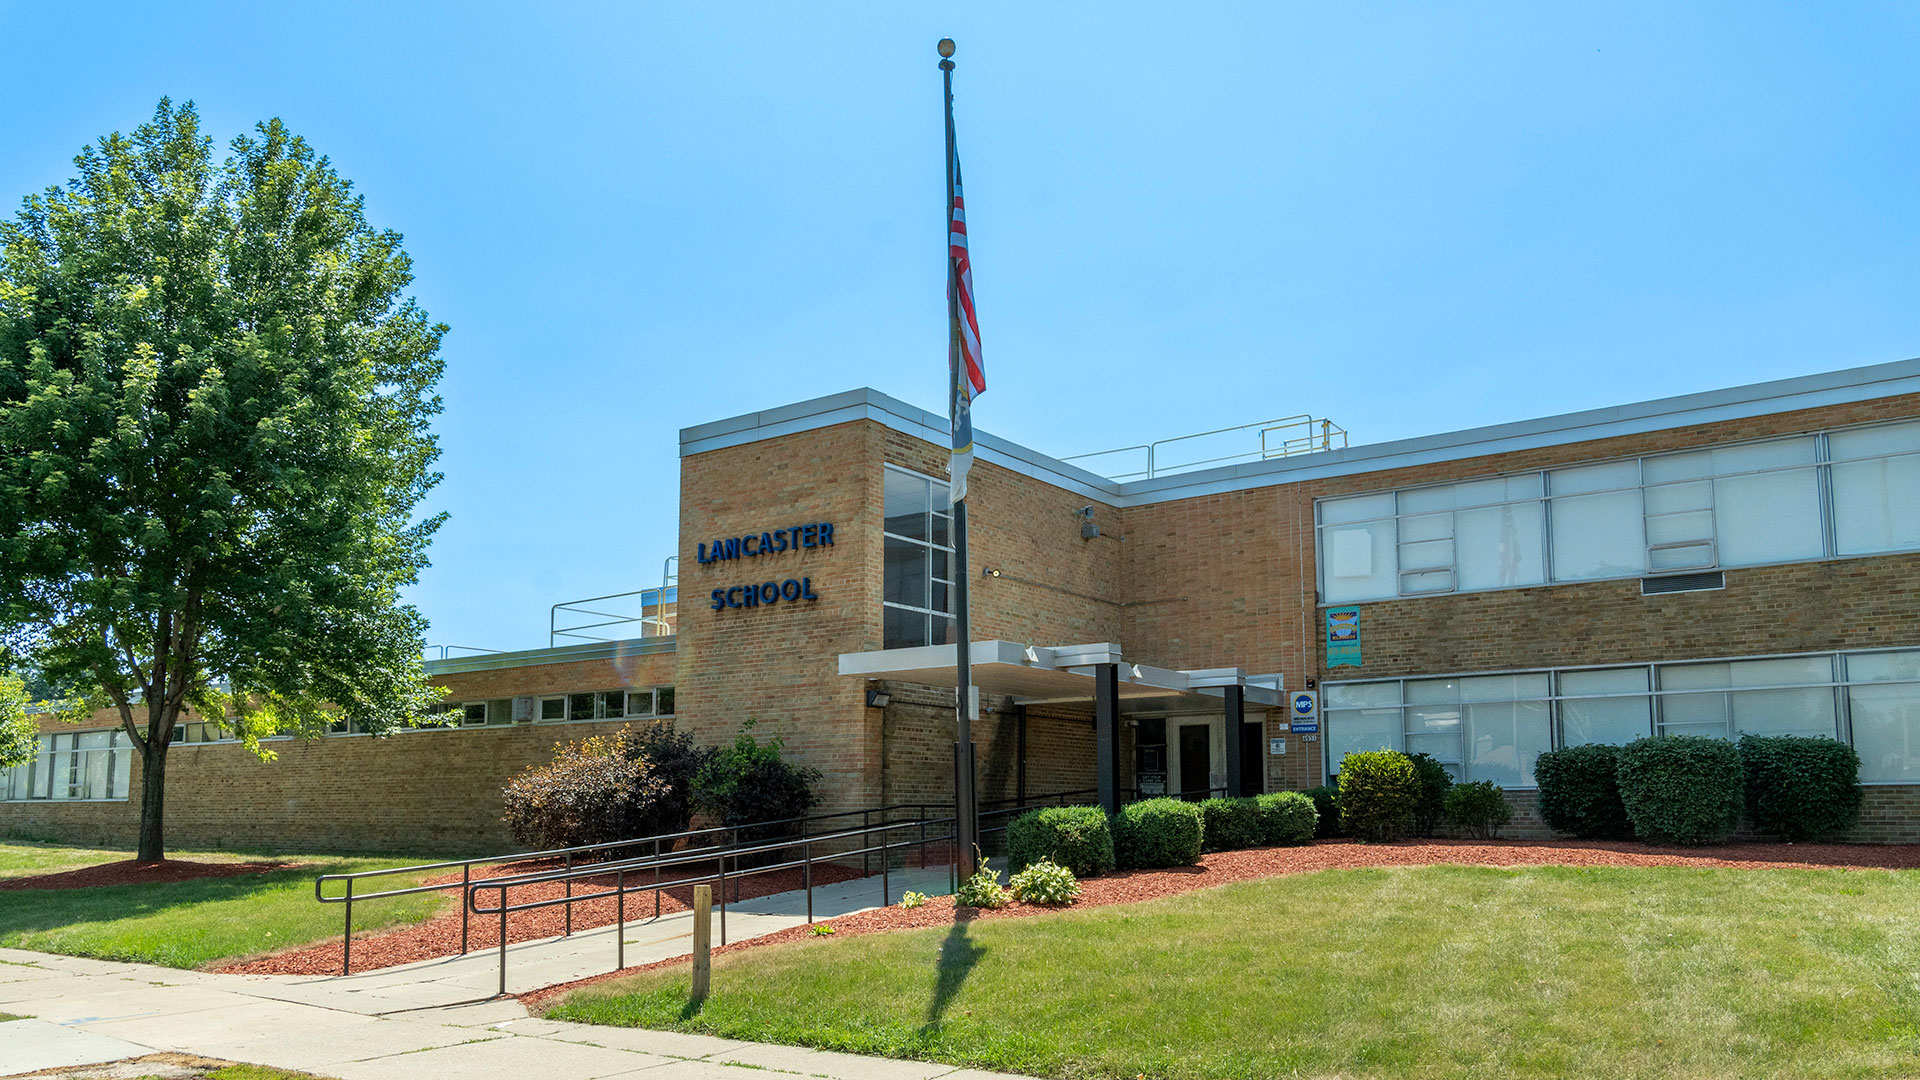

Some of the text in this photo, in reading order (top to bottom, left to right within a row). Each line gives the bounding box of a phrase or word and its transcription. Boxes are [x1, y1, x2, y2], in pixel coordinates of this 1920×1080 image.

[697, 522, 834, 564] LANCASTER
[711, 577, 818, 610] SCHOOL
[1295, 700, 1313, 709] MPS
